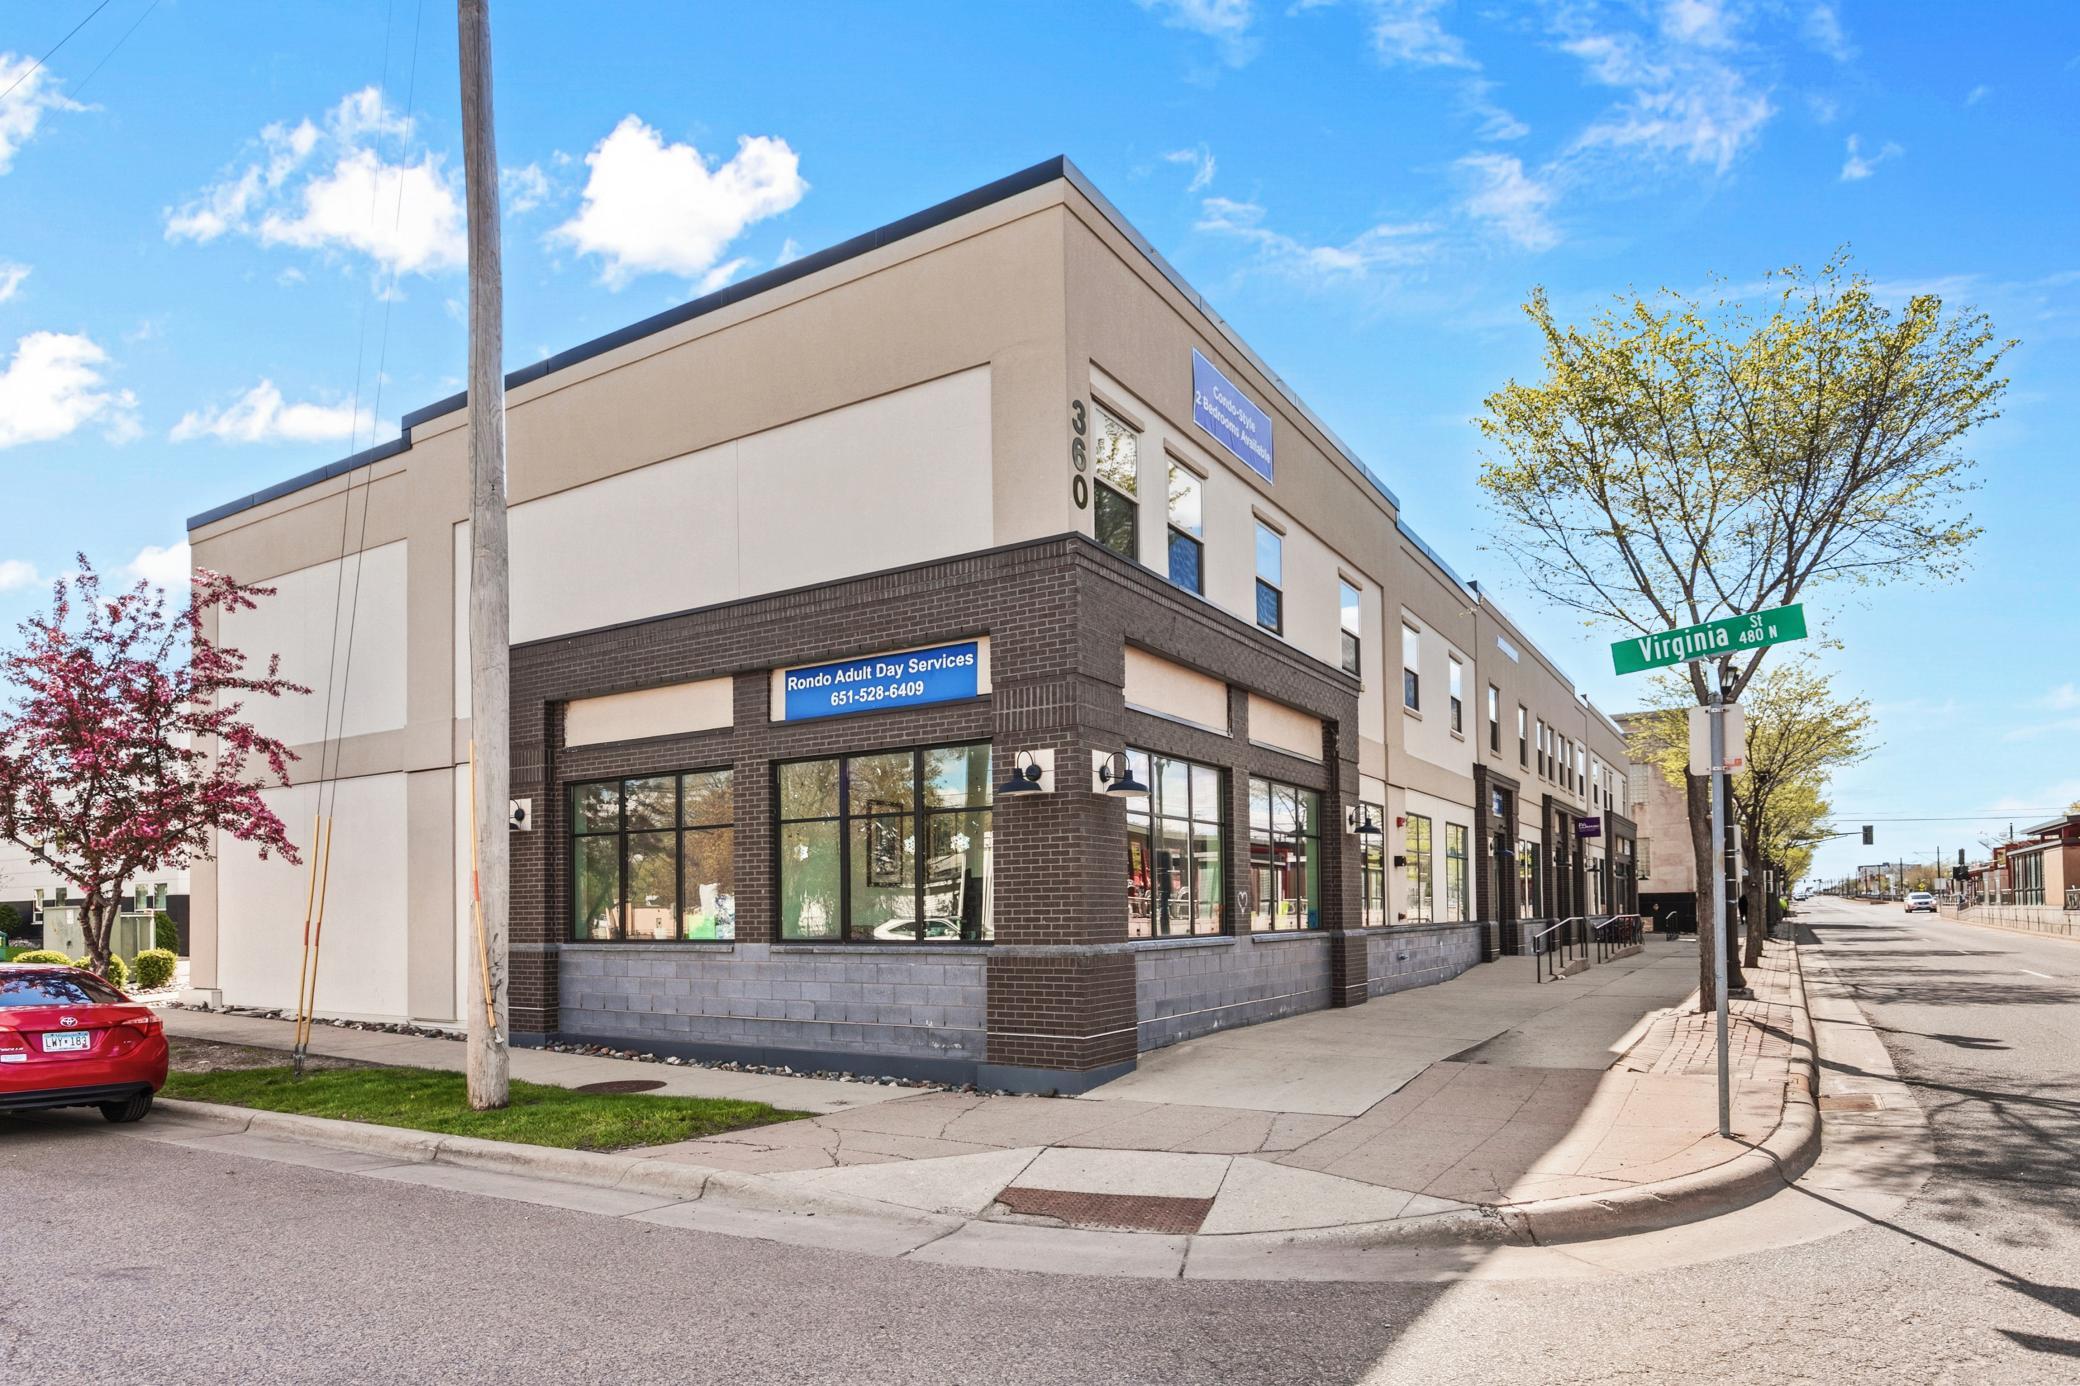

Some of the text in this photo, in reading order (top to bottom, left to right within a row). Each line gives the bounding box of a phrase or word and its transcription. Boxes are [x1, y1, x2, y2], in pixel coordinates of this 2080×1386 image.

[1195, 391, 1270, 463] 2 Bedrooms Available
[1213, 386, 1256, 433] Condo-Style
[1072, 399, 1088, 511] 360
[1749, 615, 1763, 628] St
[1638, 624, 1778, 662] Virginia 480 N
[787, 653, 974, 691] Rondo Adult Day Services
[830, 681, 924, 706] 651-528-6409
